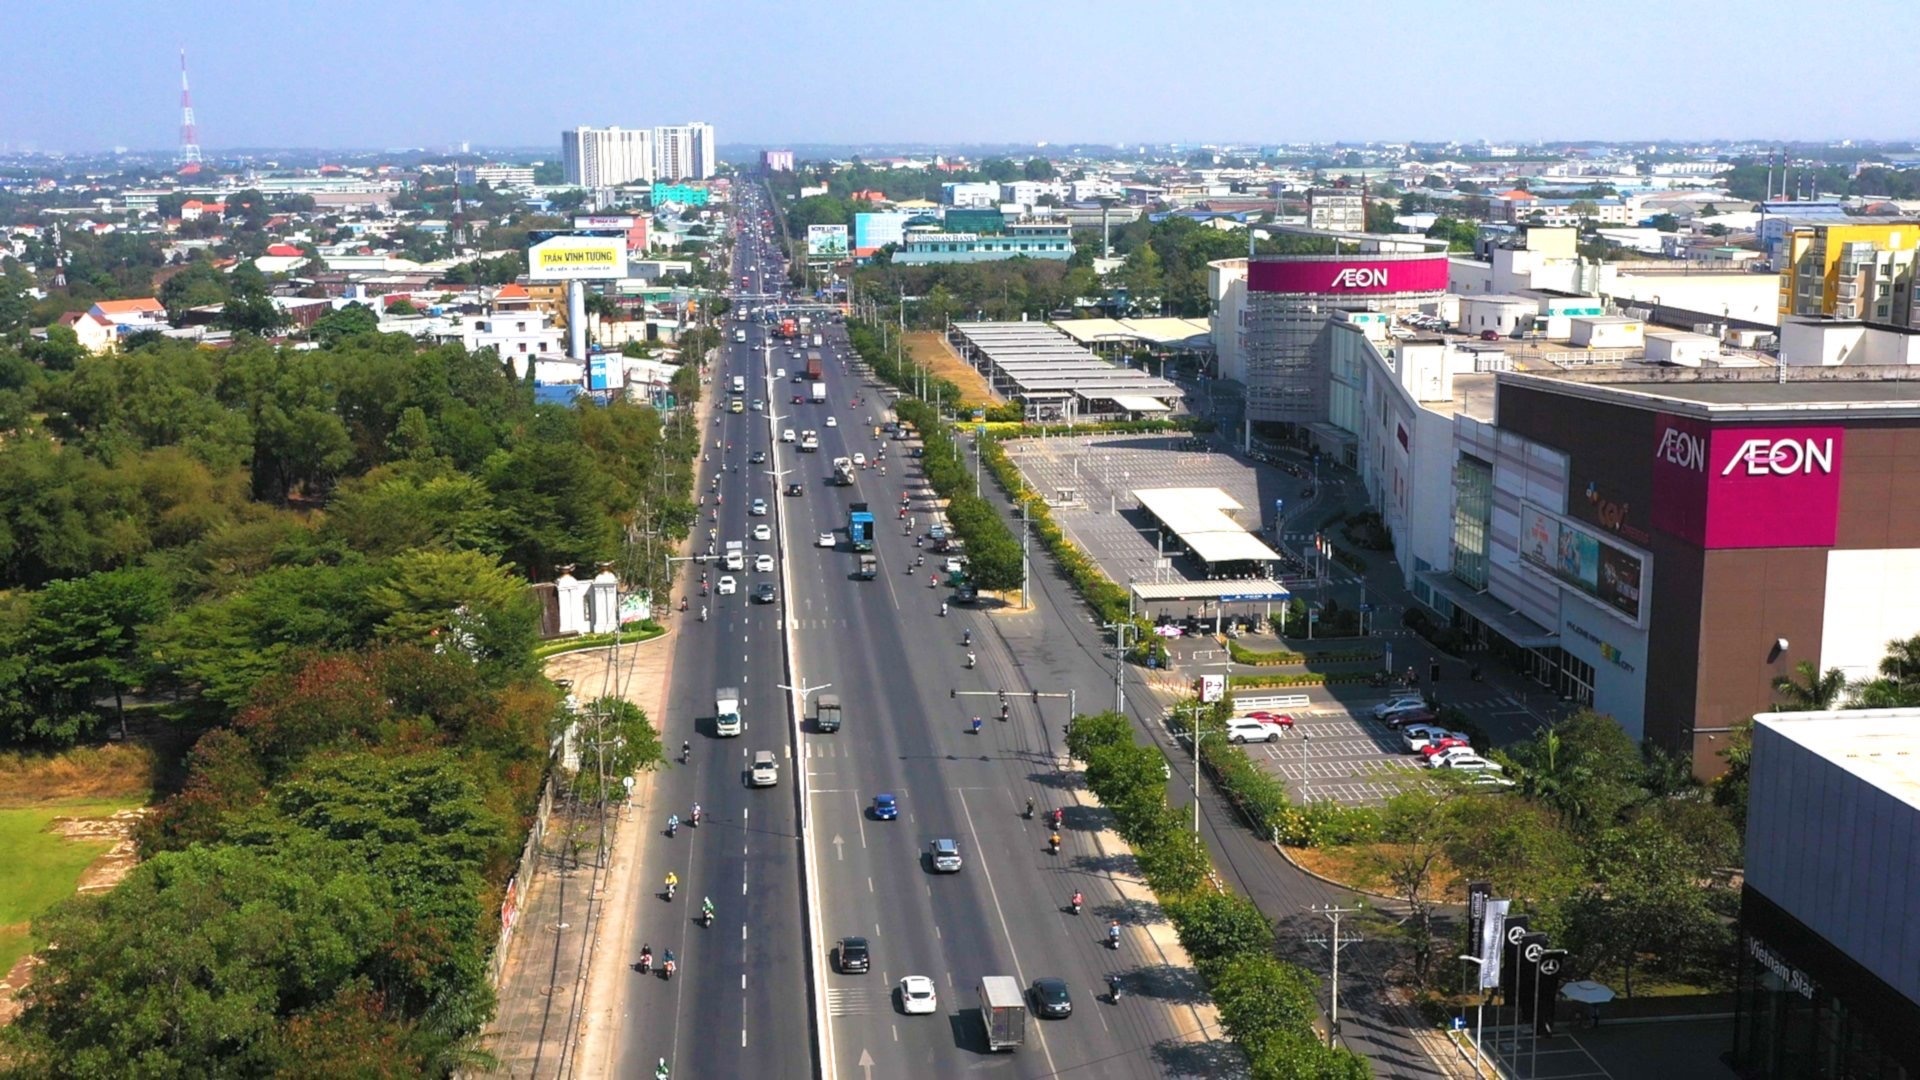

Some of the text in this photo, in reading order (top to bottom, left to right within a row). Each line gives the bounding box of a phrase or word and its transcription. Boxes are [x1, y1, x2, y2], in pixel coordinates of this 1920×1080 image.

[953, 233, 975, 242] BANK
[1205, 681, 1212, 691] P
[1750, 936, 1814, 1001] Vietnam Star
